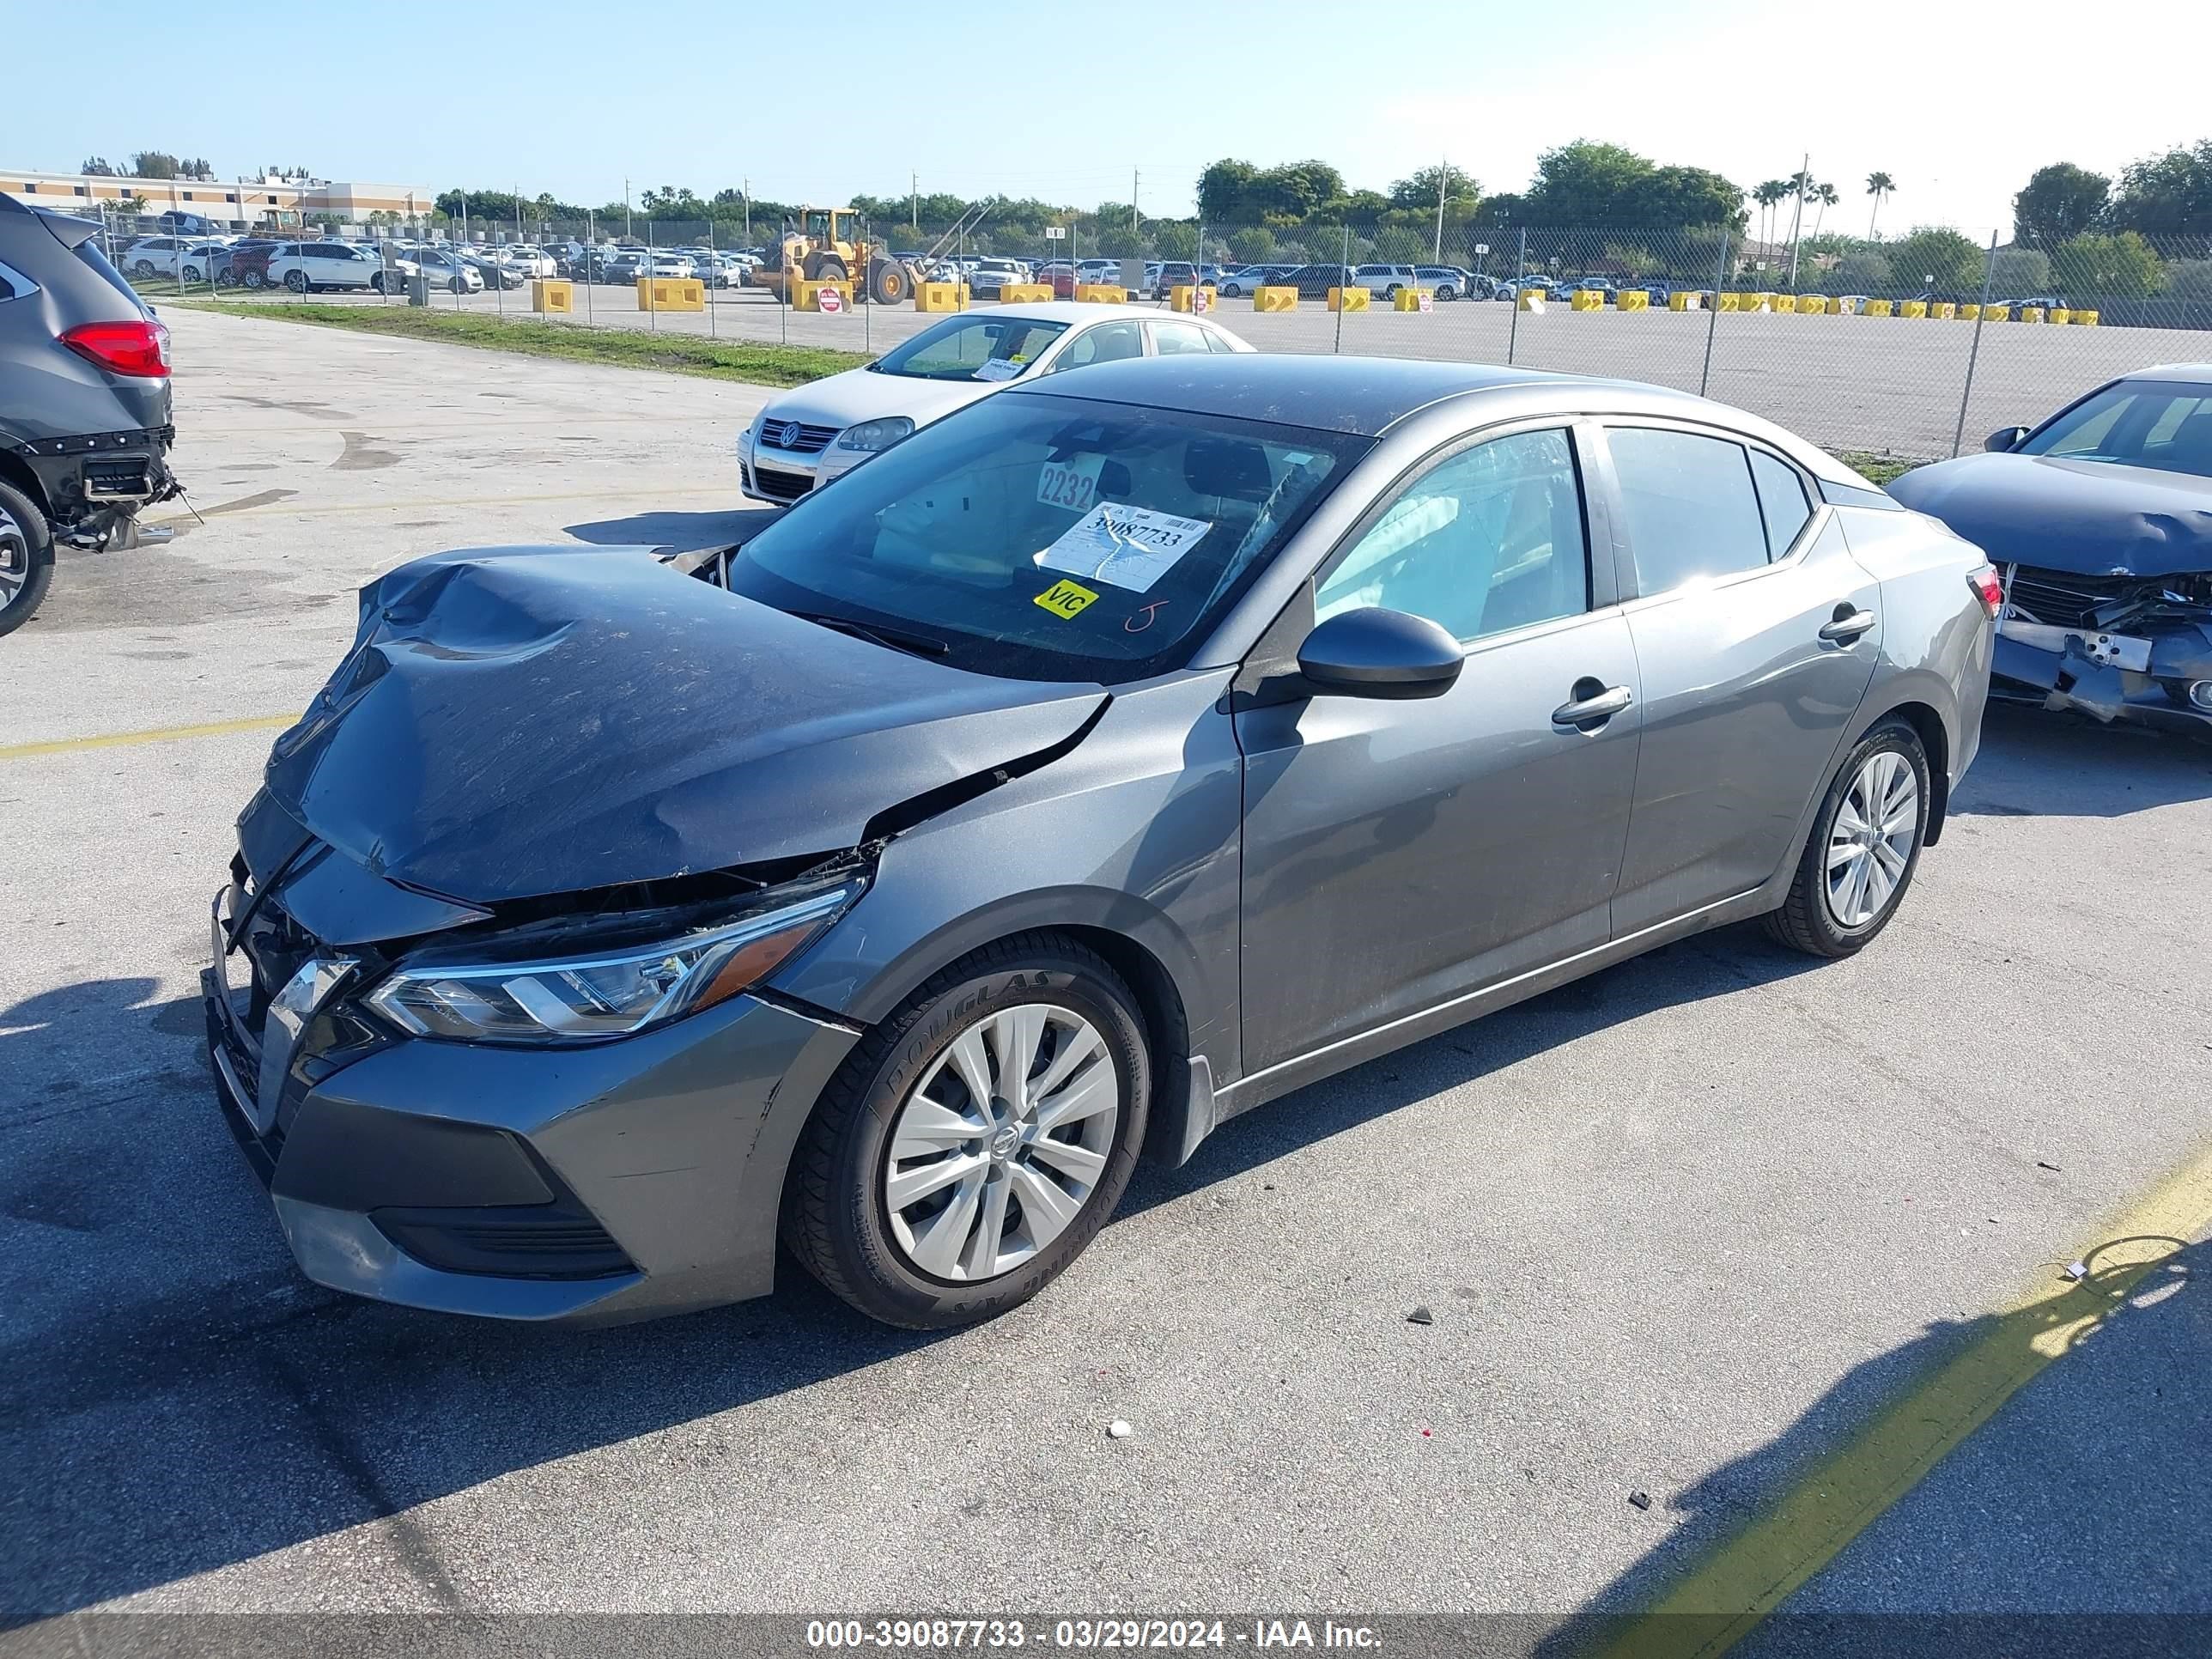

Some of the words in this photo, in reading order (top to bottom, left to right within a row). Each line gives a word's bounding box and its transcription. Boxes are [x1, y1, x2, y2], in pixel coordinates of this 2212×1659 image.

[1041, 468, 1094, 509] 2232
[1086, 517, 1182, 547] 39087733
[1048, 586, 1086, 611] VIC
[1124, 600, 1170, 632] J
[886, 970, 1052, 1097] DOUGLAS
